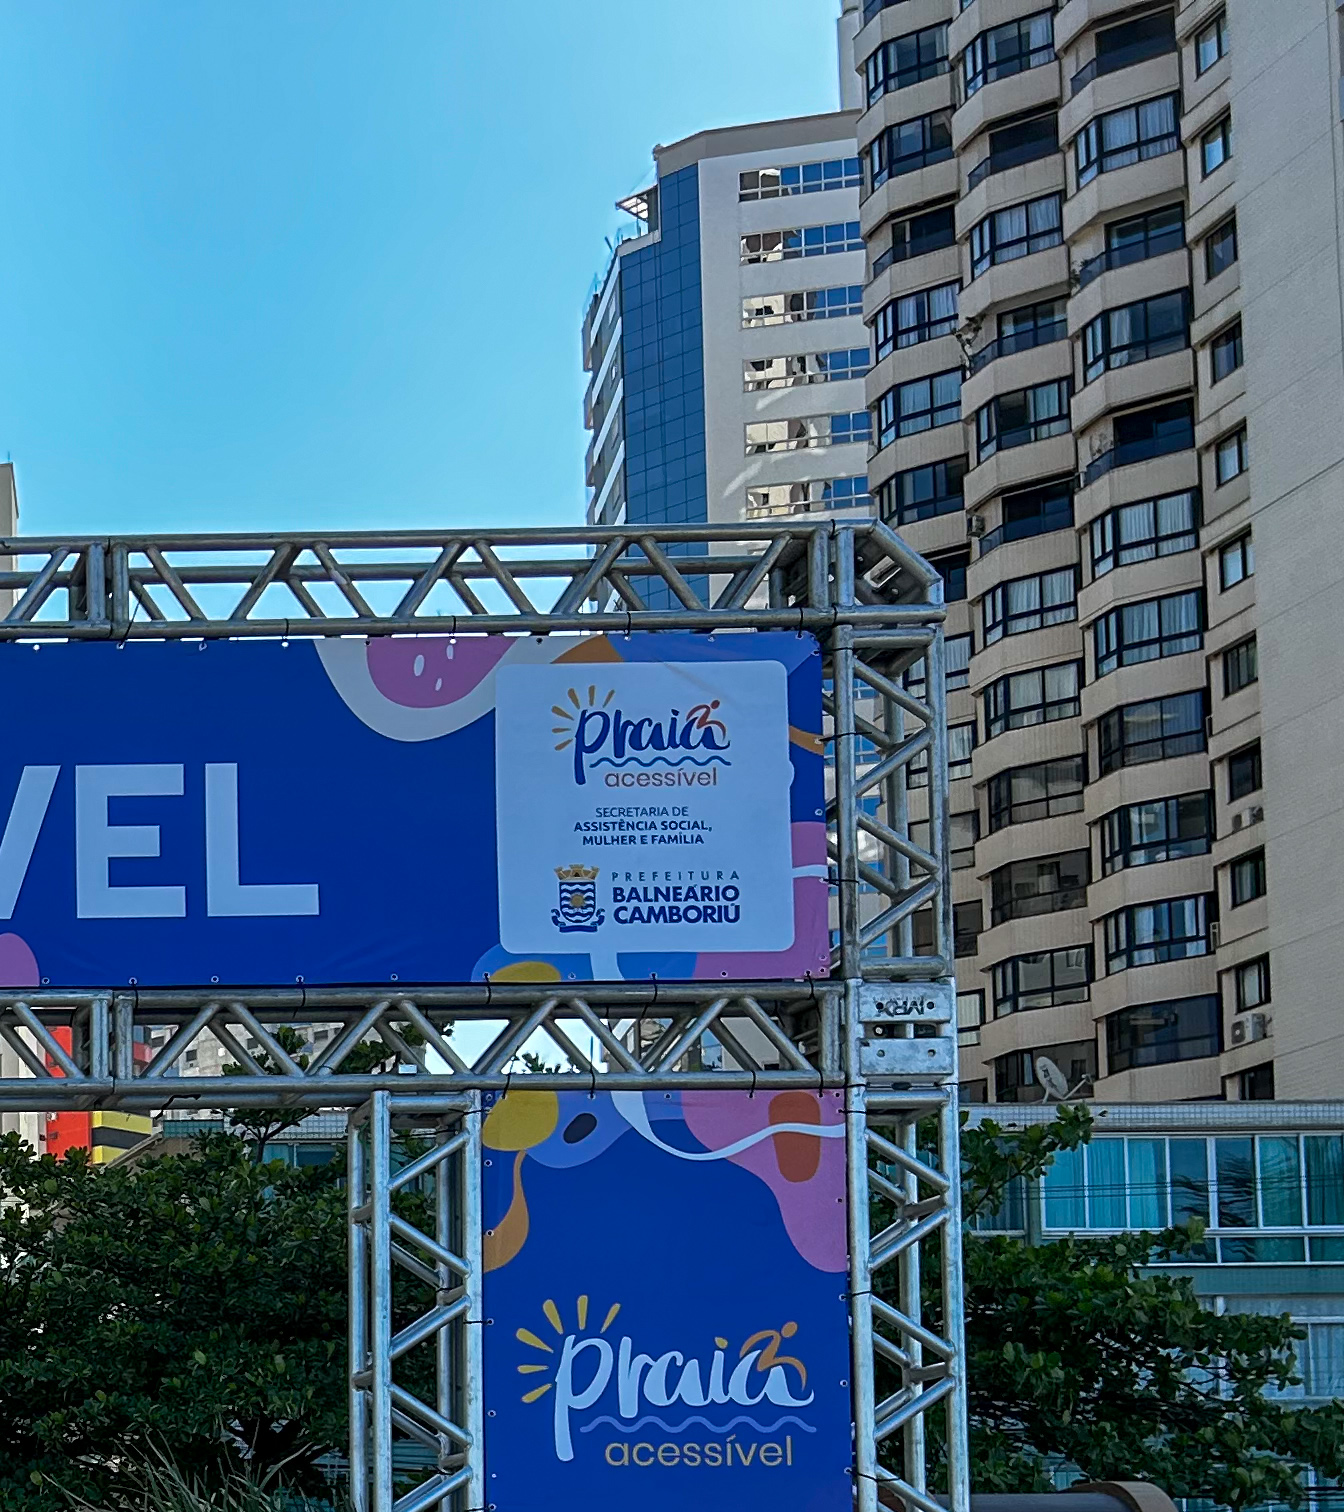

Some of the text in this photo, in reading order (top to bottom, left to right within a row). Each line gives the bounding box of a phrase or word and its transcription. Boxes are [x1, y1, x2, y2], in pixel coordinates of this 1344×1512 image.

[573, 706, 731, 786] praia
[604, 767, 717, 787] acessível
[595, 806, 689, 818] SECRETARIA DE
[573, 818, 713, 833] ASSISTÊNCIA SOCIAL,
[582, 832, 705, 846] MULHER E FAMÍLIA
[611, 870, 741, 882] PREFEITURA
[612, 884, 740, 903] BALNEÁRIO
[613, 903, 741, 925] CAMBORIÚ
[553, 1334, 815, 1462] praia
[604, 1433, 793, 1467] acessível
